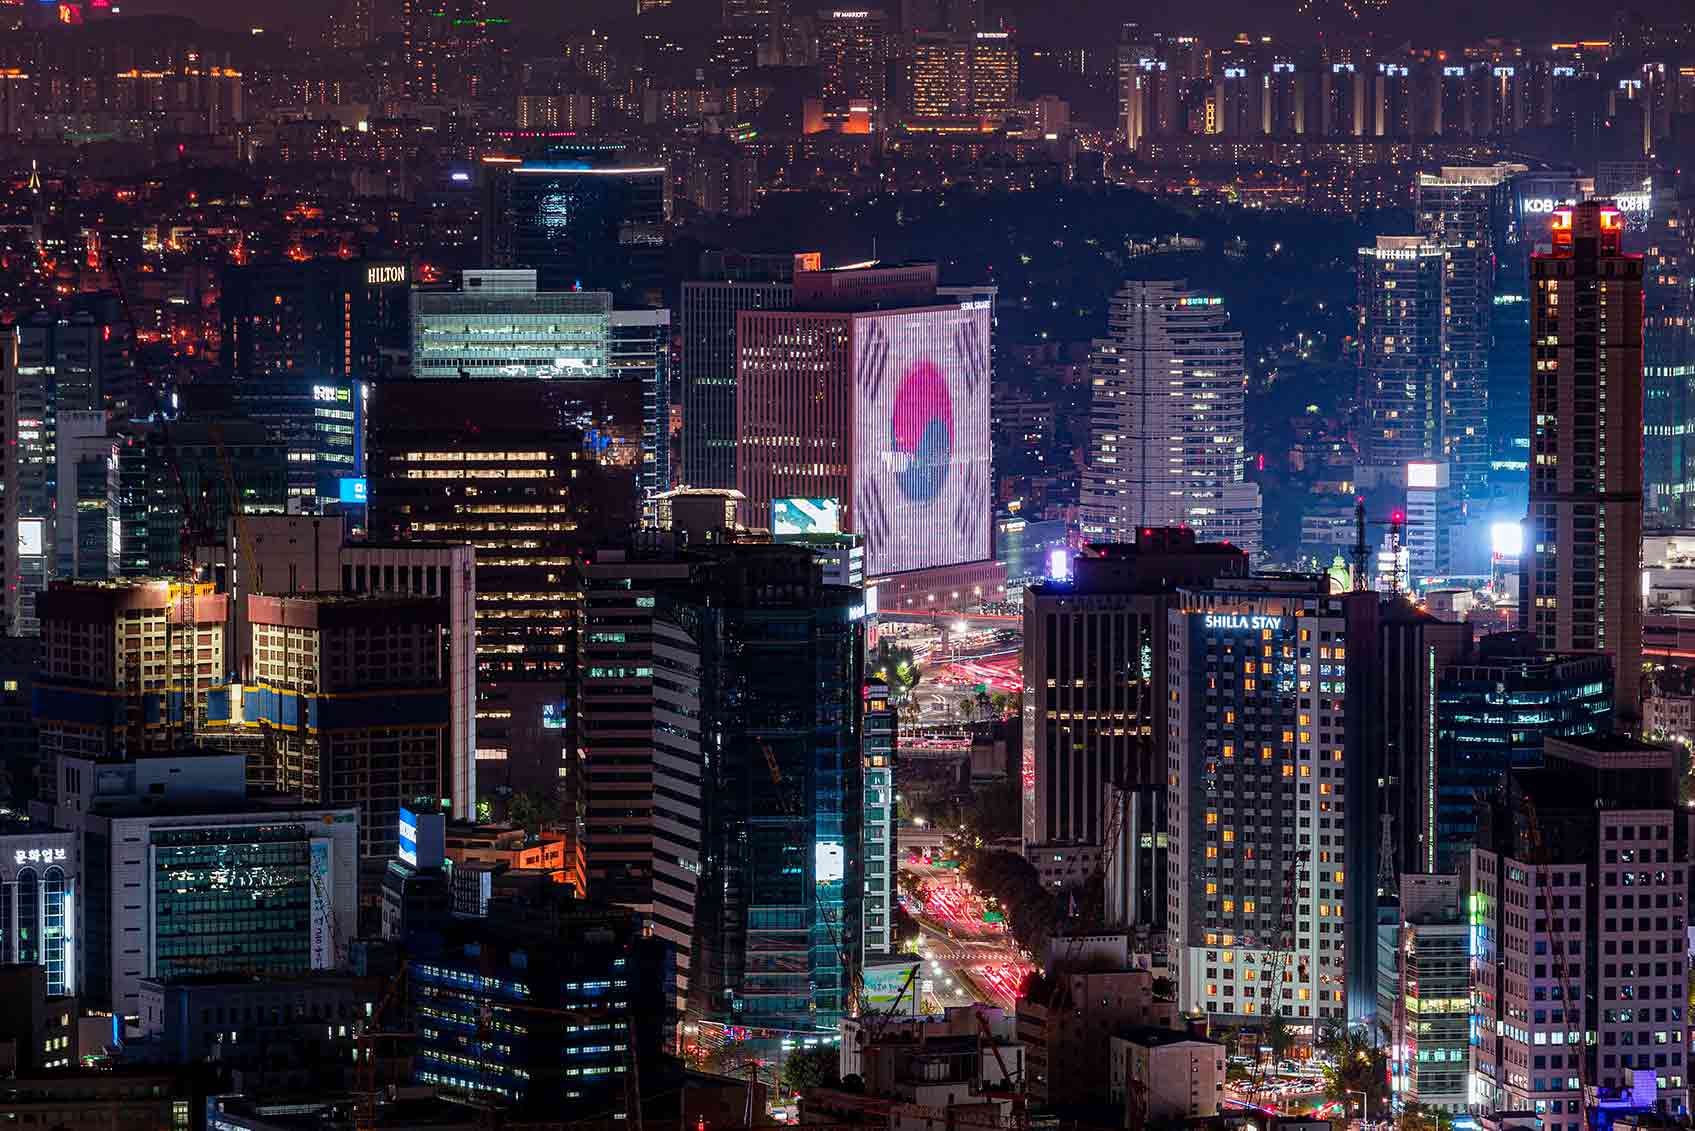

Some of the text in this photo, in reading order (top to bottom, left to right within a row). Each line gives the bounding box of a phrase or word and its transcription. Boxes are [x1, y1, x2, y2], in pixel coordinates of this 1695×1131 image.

[368, 266, 405, 283] HILTON
[960, 302, 974, 310] SEOUL
[1205, 615, 1281, 629] SHILLA STAY
[14, 848, 67, 864] 문화일보
